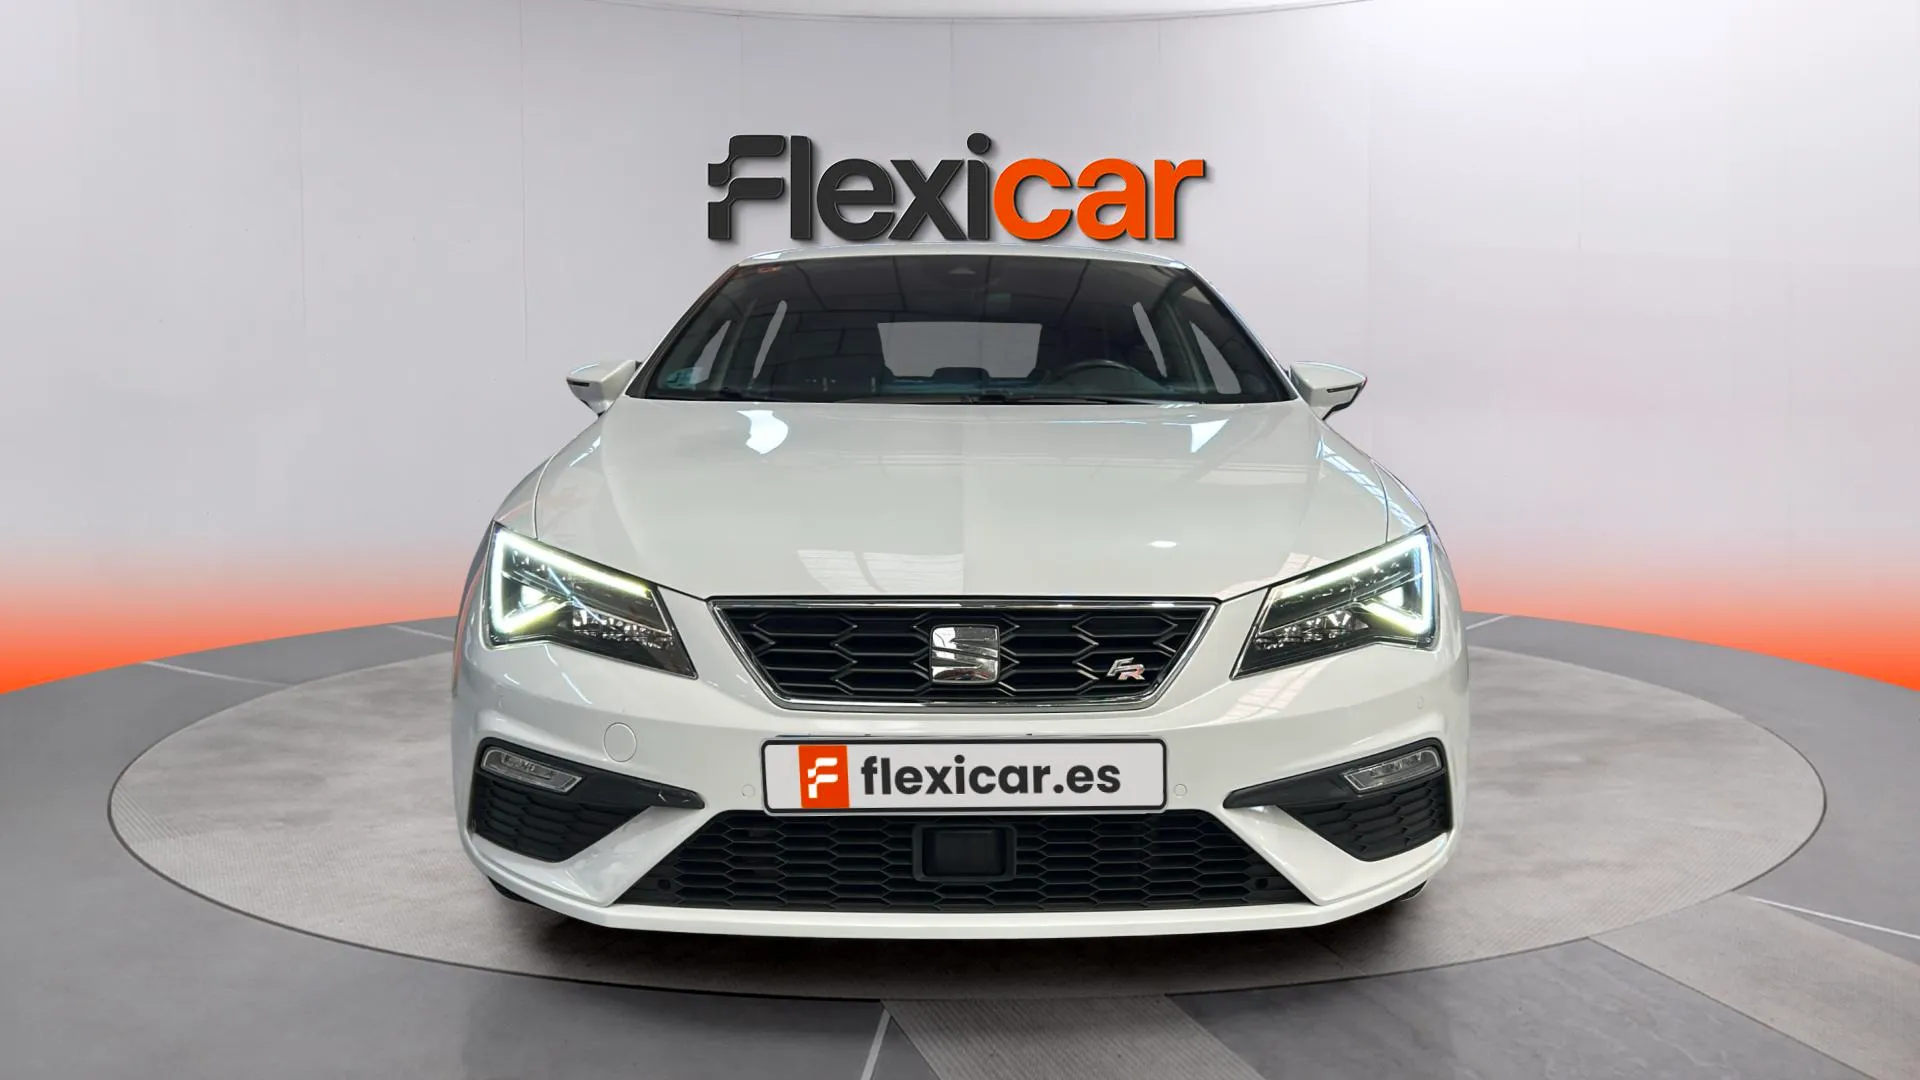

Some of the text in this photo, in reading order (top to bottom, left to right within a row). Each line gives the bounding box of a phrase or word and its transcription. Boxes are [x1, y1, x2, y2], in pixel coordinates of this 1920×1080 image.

[708, 132, 1206, 240] Flexicar
[1106, 657, 1145, 680] FR
[861, 754, 1121, 795] flexicar.es
